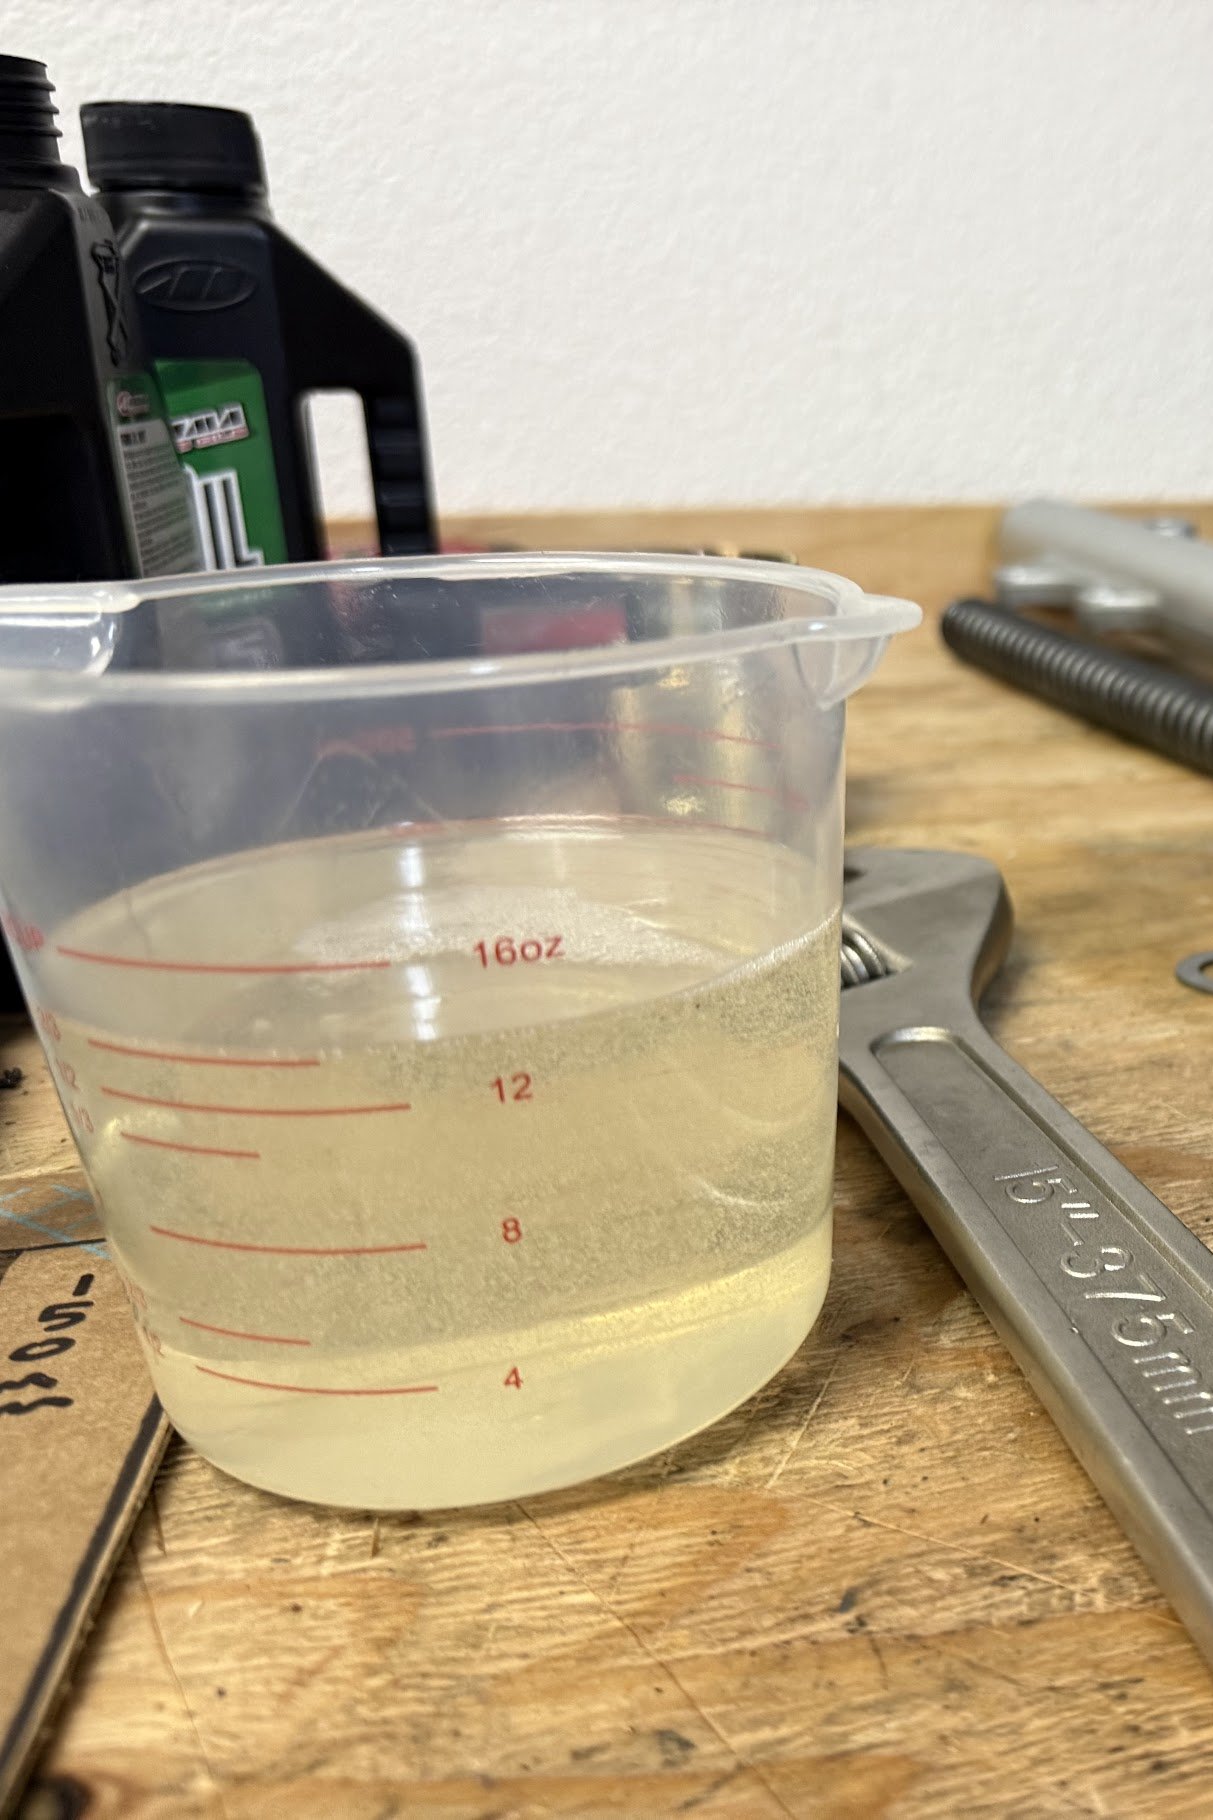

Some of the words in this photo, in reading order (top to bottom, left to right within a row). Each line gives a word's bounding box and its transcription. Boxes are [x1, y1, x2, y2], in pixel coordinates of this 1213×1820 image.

[473, 935, 566, 969] 16oz
[490, 1072, 533, 1103] 12
[501, 1217, 523, 1245] 8
[503, 1366, 525, 1391] 4
